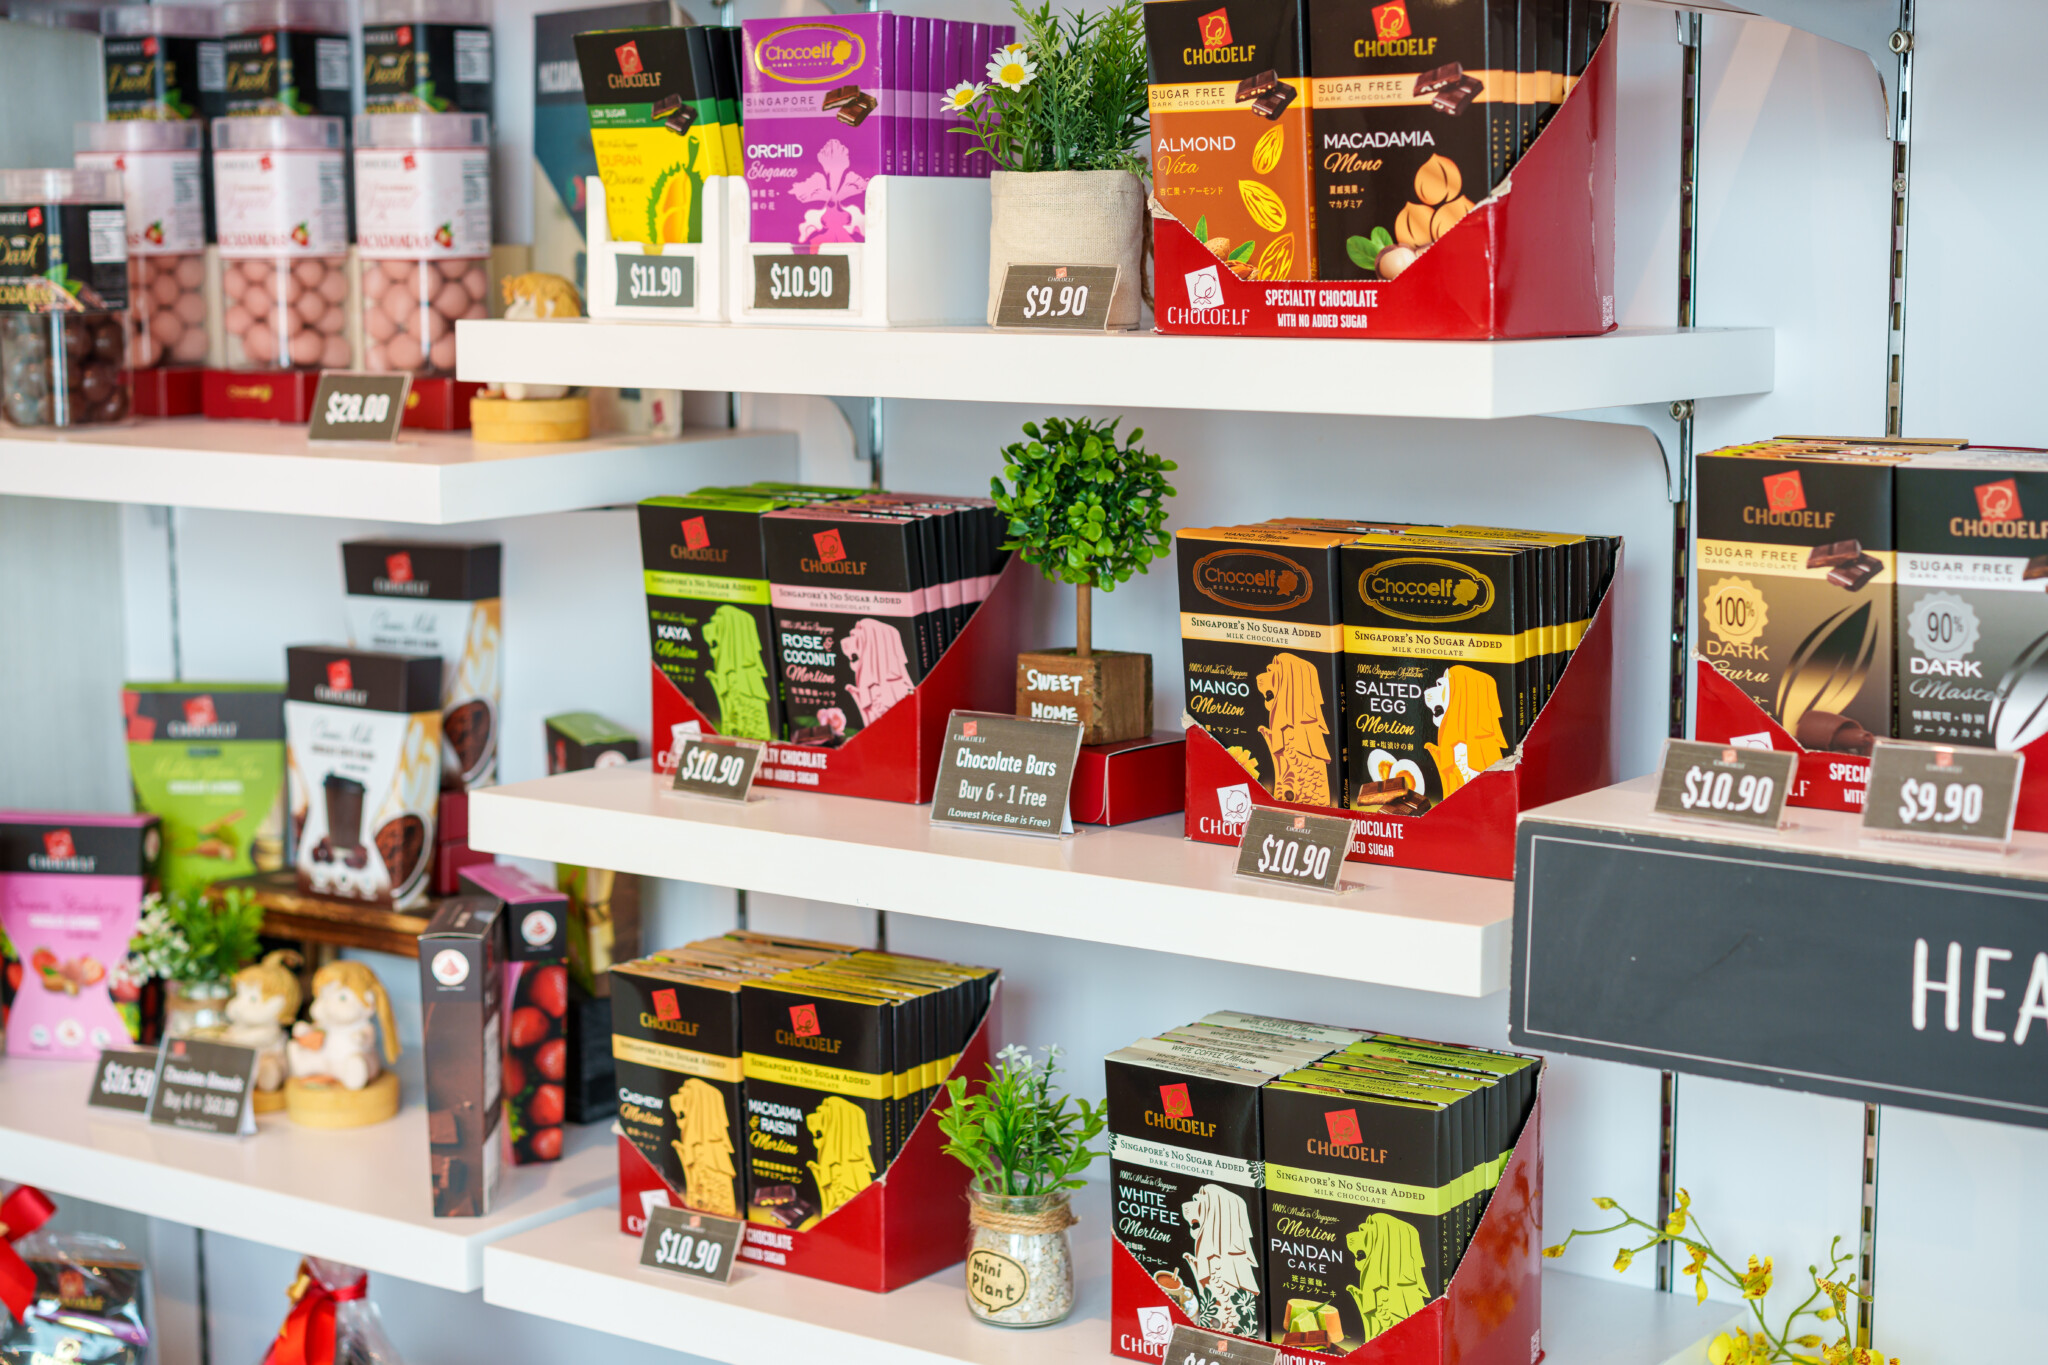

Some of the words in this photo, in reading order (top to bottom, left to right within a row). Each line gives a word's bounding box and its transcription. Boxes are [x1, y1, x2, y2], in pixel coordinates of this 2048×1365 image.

[766, 42, 831, 61] Chocoelf
[1183, 45, 1256, 65] CHOCOELF
[1354, 37, 1437, 57] CHOCOELF
[608, 72, 662, 89] CHOCOELF
[1319, 83, 1361, 94] SUGAR
[1369, 81, 1402, 91] FREE
[746, 96, 815, 107] SINGAPORE
[1152, 90, 1189, 99] SUGAR
[1196, 87, 1225, 97] FREE
[606, 108, 627, 118] SUGAR
[1157, 136, 1235, 152] ALMOND
[1324, 131, 1435, 149] MACADAMIA
[747, 144, 803, 159] ORCHID
[747, 161, 798, 182] Elegance
[1157, 154, 1199, 175] Vita
[1324, 152, 1383, 173] Mono
[1329, 200, 1363, 209] マカダミア
[630, 262, 682, 299] $11.90
[770, 262, 833, 300] $10.90
[1023, 285, 1088, 319] $9.90
[1265, 289, 1315, 307] SPECIALTY
[1319, 290, 1378, 307] CHOCOLATE
[1167, 306, 1250, 326] CHOCOELF
[1277, 313, 1296, 327] WITH
[1298, 314, 1309, 328] NO
[1312, 314, 1338, 328] ADDED
[1340, 315, 1367, 329] SUGAR
[325, 391, 390, 425] $28.00
[1743, 506, 1836, 529] CHOCOELF
[1949, 517, 2048, 539] CHOCOELF
[1705, 546, 1753, 559] SUGAR
[1761, 550, 1798, 563] FREE
[1705, 557, 1731, 566] DARK
[1738, 560, 1798, 571] CHOCOLATE
[800, 557, 867, 575] CHOCOELF
[1909, 560, 1964, 573] SUGAR
[1973, 562, 2013, 574] FREE
[1205, 567, 1276, 587] Chocoelf
[1372, 577, 1453, 597] Chocoelf
[844, 593, 870, 603] SUGAR
[873, 595, 901, 605] ADDED
[1716, 595, 1755, 627] 100%
[657, 625, 692, 642] KAYA
[1191, 617, 1245, 631] SINGAPORE'S
[1247, 622, 1260, 632] NO
[1262, 624, 1289, 635] SUGAR
[1292, 627, 1321, 638] ADDED
[1927, 611, 1963, 643] 90%
[782, 633, 823, 650] ROSE
[1226, 632, 1244, 640] MILK
[1247, 634, 1289, 645] CHOCOLATE
[1355, 631, 1413, 644] SINGAPORE'S
[1416, 635, 1430, 645] NO
[1433, 636, 1465, 647] SUGAR
[1468, 638, 1502, 649] ADDED
[783, 649, 836, 667] COCONUT
[1392, 646, 1412, 654] MILK
[1414, 647, 1464, 657] CHOCOLATE
[1706, 640, 1769, 661] DARK
[786, 665, 836, 684] Merlion
[1910, 657, 1982, 678] DARK
[1027, 669, 1083, 696] SWEET
[1190, 678, 1249, 697] MANGO
[1355, 680, 1422, 699] SALTED
[1031, 702, 1078, 722] HOME
[1191, 695, 1245, 716] Merlion
[1370, 698, 1407, 714] EGG
[1356, 714, 1415, 736] Merlion
[681, 746, 745, 786] $10.90
[781, 751, 827, 769] CHOCOLATE
[956, 747, 1022, 773] Chocolate
[1025, 754, 1056, 776] Bars
[797, 771, 819, 785] SUGAR
[958, 779, 982, 802] Buy
[985, 782, 995, 801] 6
[1006, 784, 1015, 804] 1
[1018, 786, 1047, 807] Free
[1681, 766, 1773, 814] $10.90
[1899, 779, 1983, 824] $9.90
[948, 808, 980, 820] (Lowest
[982, 810, 1002, 823] Price
[1004, 813, 1019, 824] Bar
[1020, 814, 1027, 825] is
[1029, 816, 1051, 828] Free)
[1258, 834, 1331, 880] $10.90
[1912, 938, 2048, 1045] HEA
[640, 1012, 699, 1037] CHOCOELF
[776, 1029, 842, 1054] CHOCOELF
[1171, 1044, 1194, 1053] WHITE
[1195, 1048, 1222, 1059] COFFEE
[814, 1069, 840, 1081] SUGAR
[842, 1074, 870, 1086] ADDED
[619, 1087, 663, 1109] CASHEW
[748, 1099, 803, 1122] MACADAMIA
[760, 1118, 797, 1136] RAISIN
[1145, 1110, 1217, 1138] CHOCOELF
[749, 1130, 798, 1155] Merlion
[1306, 1138, 1388, 1164] CHOCOELF
[1120, 1140, 1170, 1158] SINGAPORE'S
[1171, 1150, 1184, 1161] NO
[1186, 1153, 1213, 1167] SUGAR
[1215, 1159, 1245, 1173] ADDED
[1149, 1158, 1168, 1167] DARK
[1170, 1163, 1214, 1176] CHOCOLATE
[1276, 1169, 1336, 1188] SINGAPORE'S
[1338, 1179, 1353, 1190] NO
[1356, 1182, 1387, 1196] SUGAR
[1391, 1187, 1425, 1201] ADDED
[1119, 1185, 1167, 1208] WHITE
[1313, 1188, 1334, 1197] MILK
[1337, 1191, 1386, 1205] CHOCOLATE
[1118, 1200, 1180, 1227] COFFEE
[1272, 1202, 1287, 1214] 100%
[1312, 1209, 1340, 1225] Singapore
[1119, 1217, 1172, 1243] Merlion
[1276, 1216, 1337, 1242] Merlion
[746, 1228, 793, 1251] CHOCOLATE
[655, 1228, 722, 1274] $10.90
[1271, 1238, 1343, 1264] PANDAN
[973, 1258, 1002, 1278] mini
[1287, 1258, 1327, 1274] CAKE
[972, 1272, 1014, 1301] Plant
[1282, 1281, 1337, 1298] パンダンケーキ
